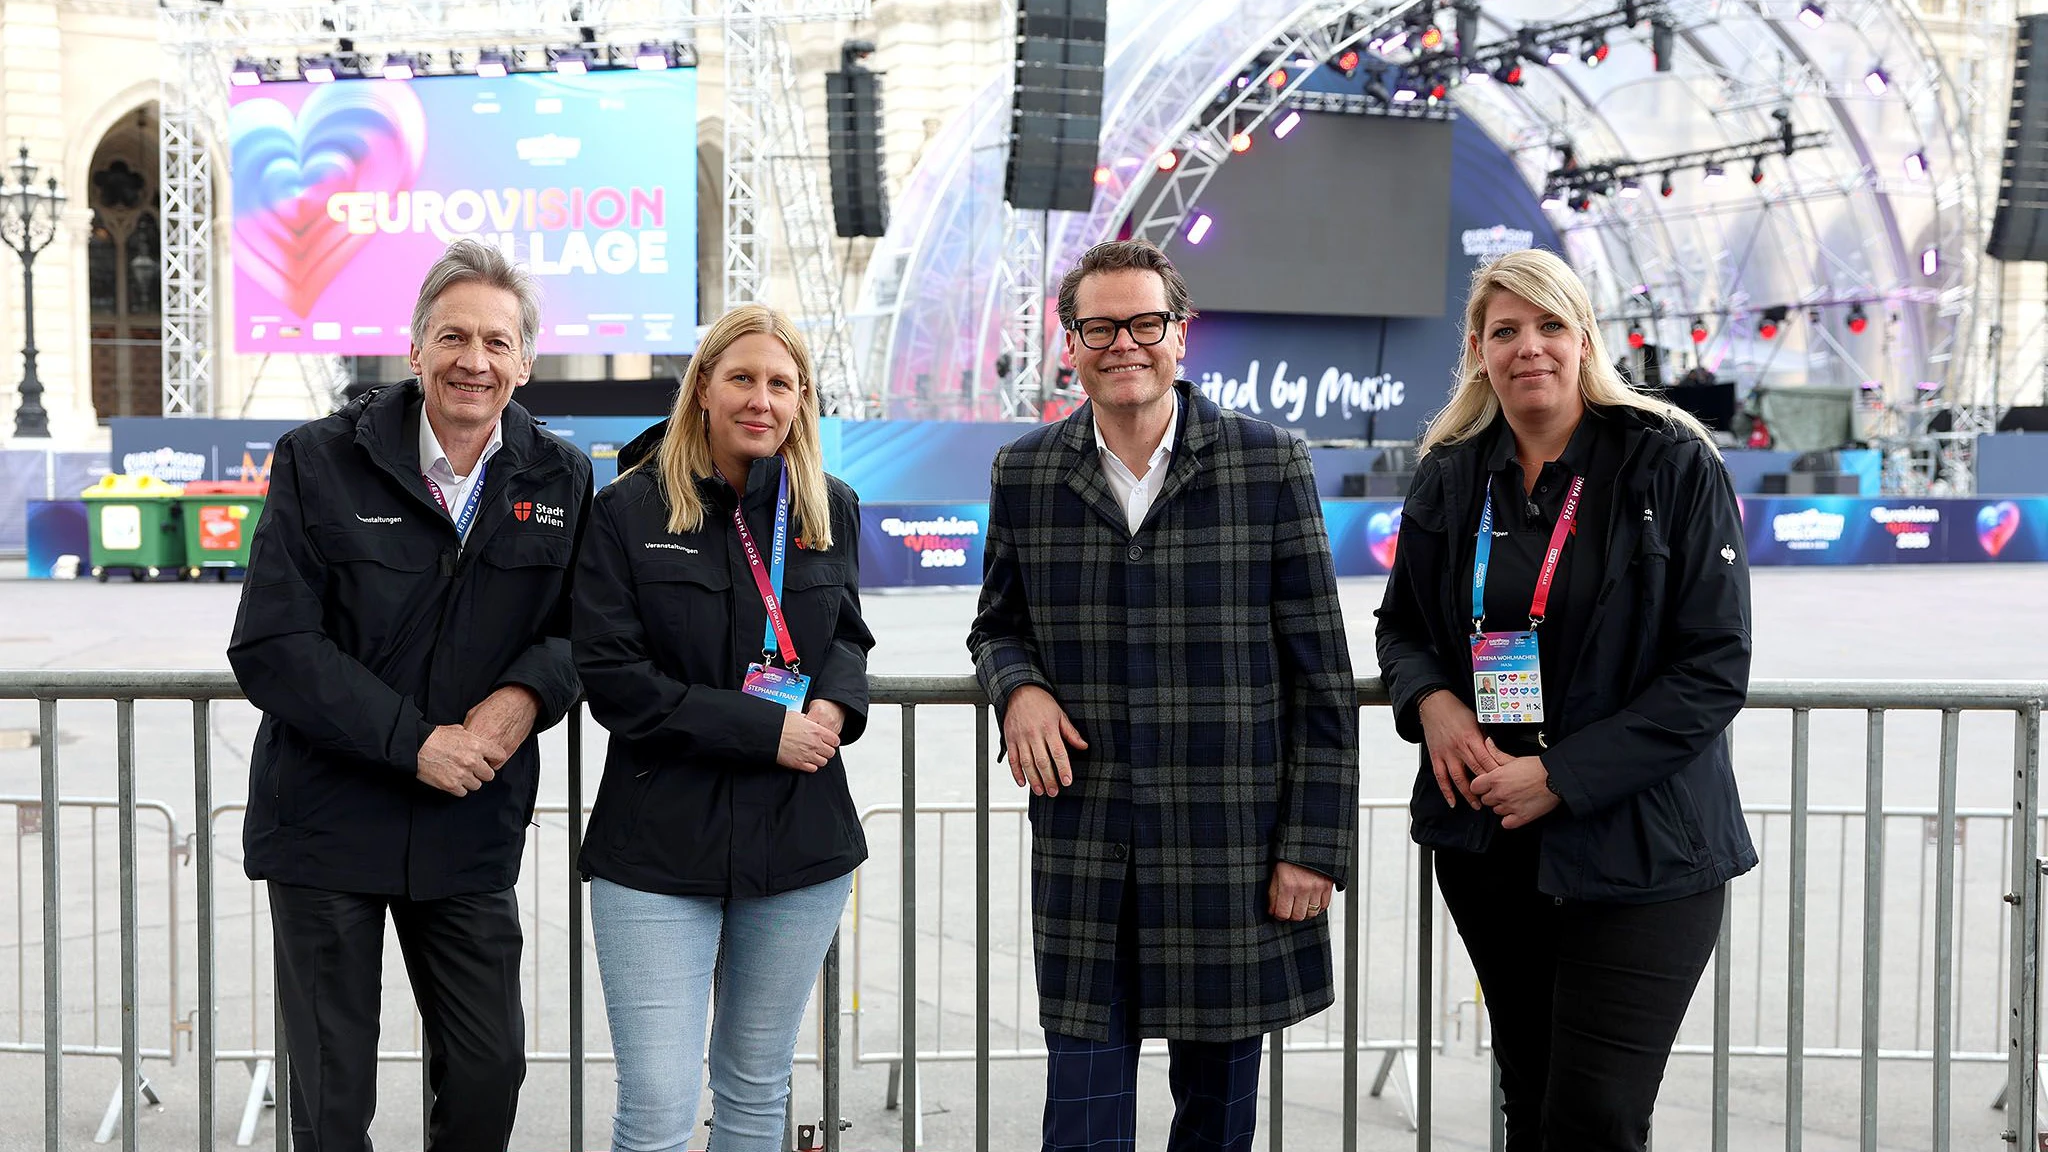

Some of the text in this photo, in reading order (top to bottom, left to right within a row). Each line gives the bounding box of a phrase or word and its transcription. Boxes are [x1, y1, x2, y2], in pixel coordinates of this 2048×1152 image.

[327, 187, 665, 240] EUROVISION
[475, 230, 668, 275] LLAGE
[1201, 360, 1405, 422] ited by Music
[456, 479, 485, 534] IENNA 2026
[535, 503, 565, 517] Stadt
[535, 513, 564, 528] Wien
[1563, 498, 1577, 521] 2026
[644, 542, 699, 554] Veranstaltungen
[735, 507, 760, 566] IENNA 2026
[774, 498, 787, 565] VIENNA 2026
[766, 595, 777, 611] ORF
[748, 684, 799, 702] STEPHANIE FRANZ
